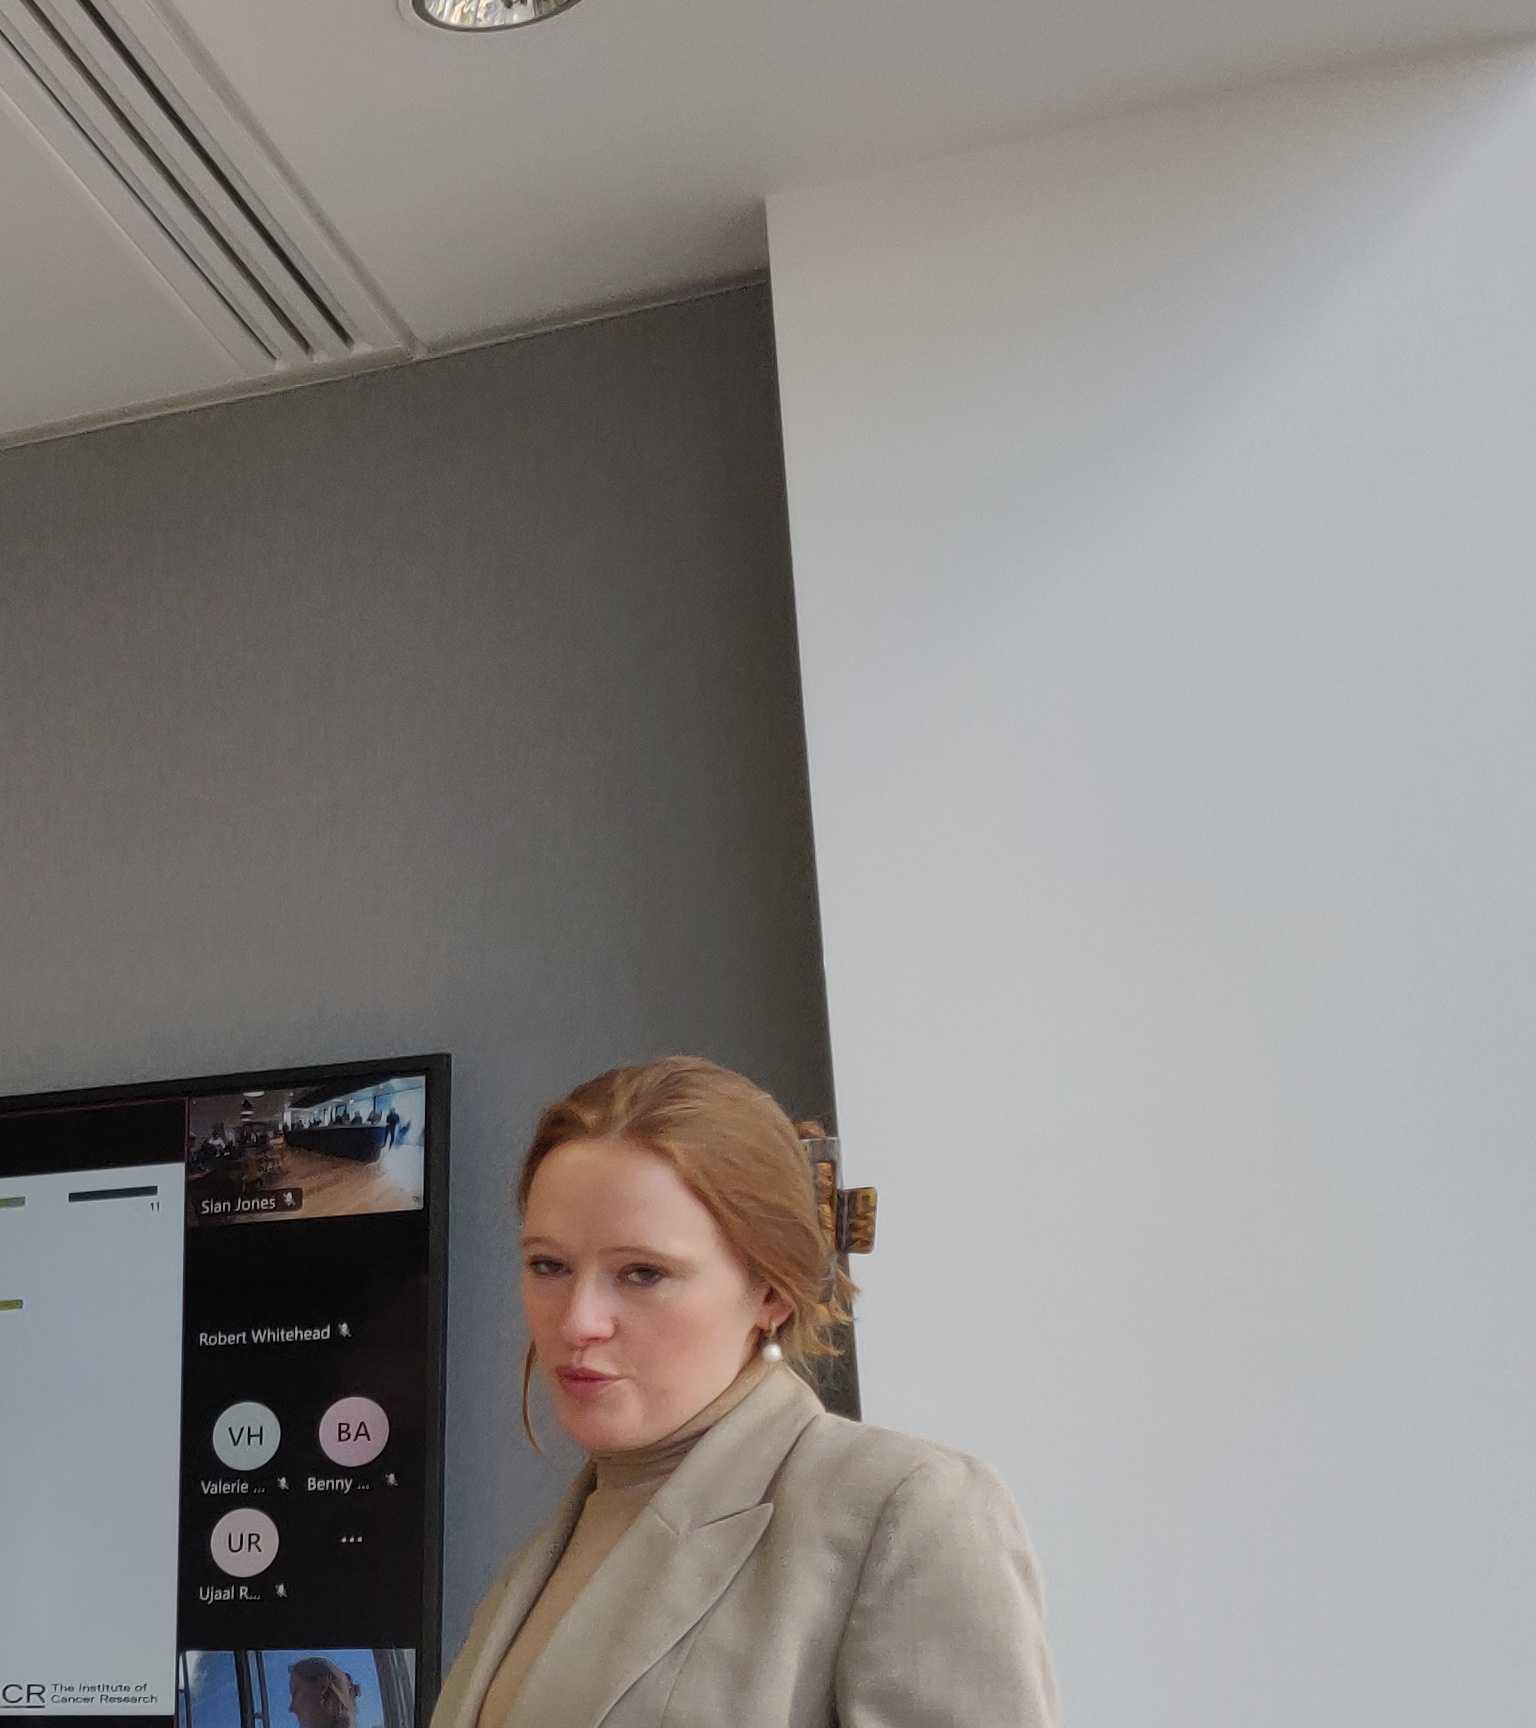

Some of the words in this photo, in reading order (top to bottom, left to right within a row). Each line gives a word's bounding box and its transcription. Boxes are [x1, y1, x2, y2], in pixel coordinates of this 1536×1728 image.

[234, 1196, 276, 1212] Jones
[199, 1331, 247, 1347] Robert
[250, 1324, 332, 1344] Whitehead
[227, 1425, 265, 1447] VH
[336, 1420, 372, 1443] BA
[200, 1478, 249, 1495] Valerie
[307, 1476, 353, 1494] Benny
[227, 1532, 262, 1553] UR
[199, 1585, 235, 1605] Ujaal
[51, 1683, 75, 1693] The
[79, 1683, 131, 1693] Institute
[134, 1683, 148, 1693] of
[50, 1694, 96, 1705] Cancer
[99, 1694, 158, 1704] Research
